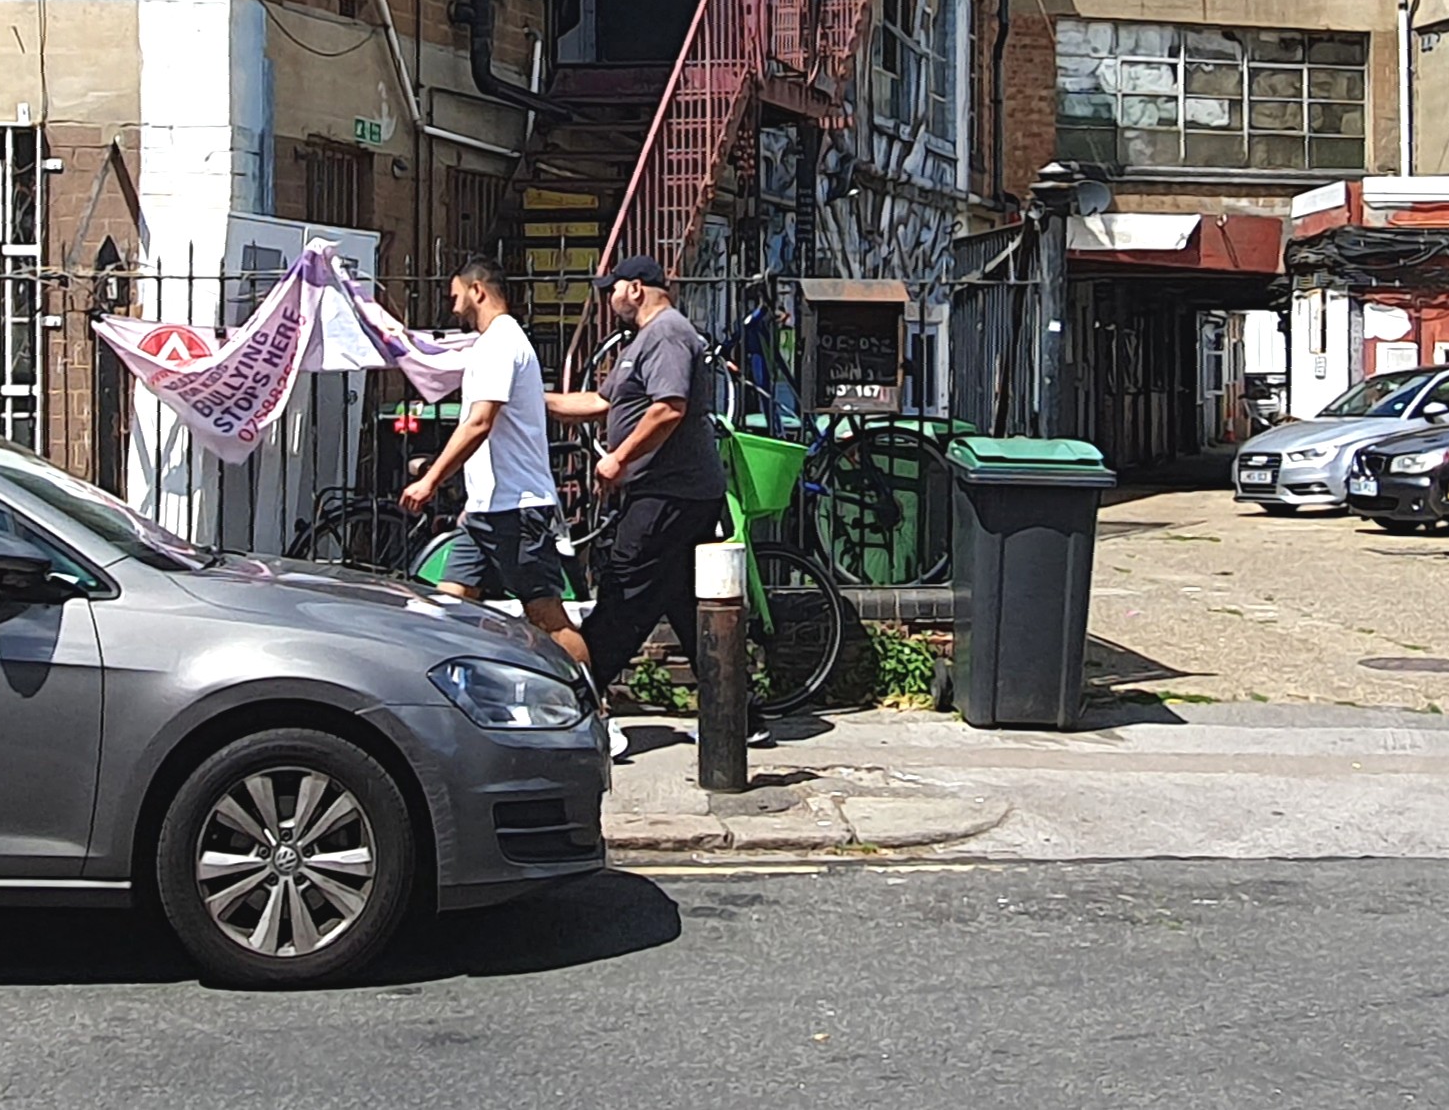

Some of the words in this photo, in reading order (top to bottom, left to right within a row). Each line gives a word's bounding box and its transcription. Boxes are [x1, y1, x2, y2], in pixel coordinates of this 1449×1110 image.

[192, 330, 269, 418] BULLYING
[213, 371, 271, 432] STOPS
[263, 306, 301, 368] HERE
